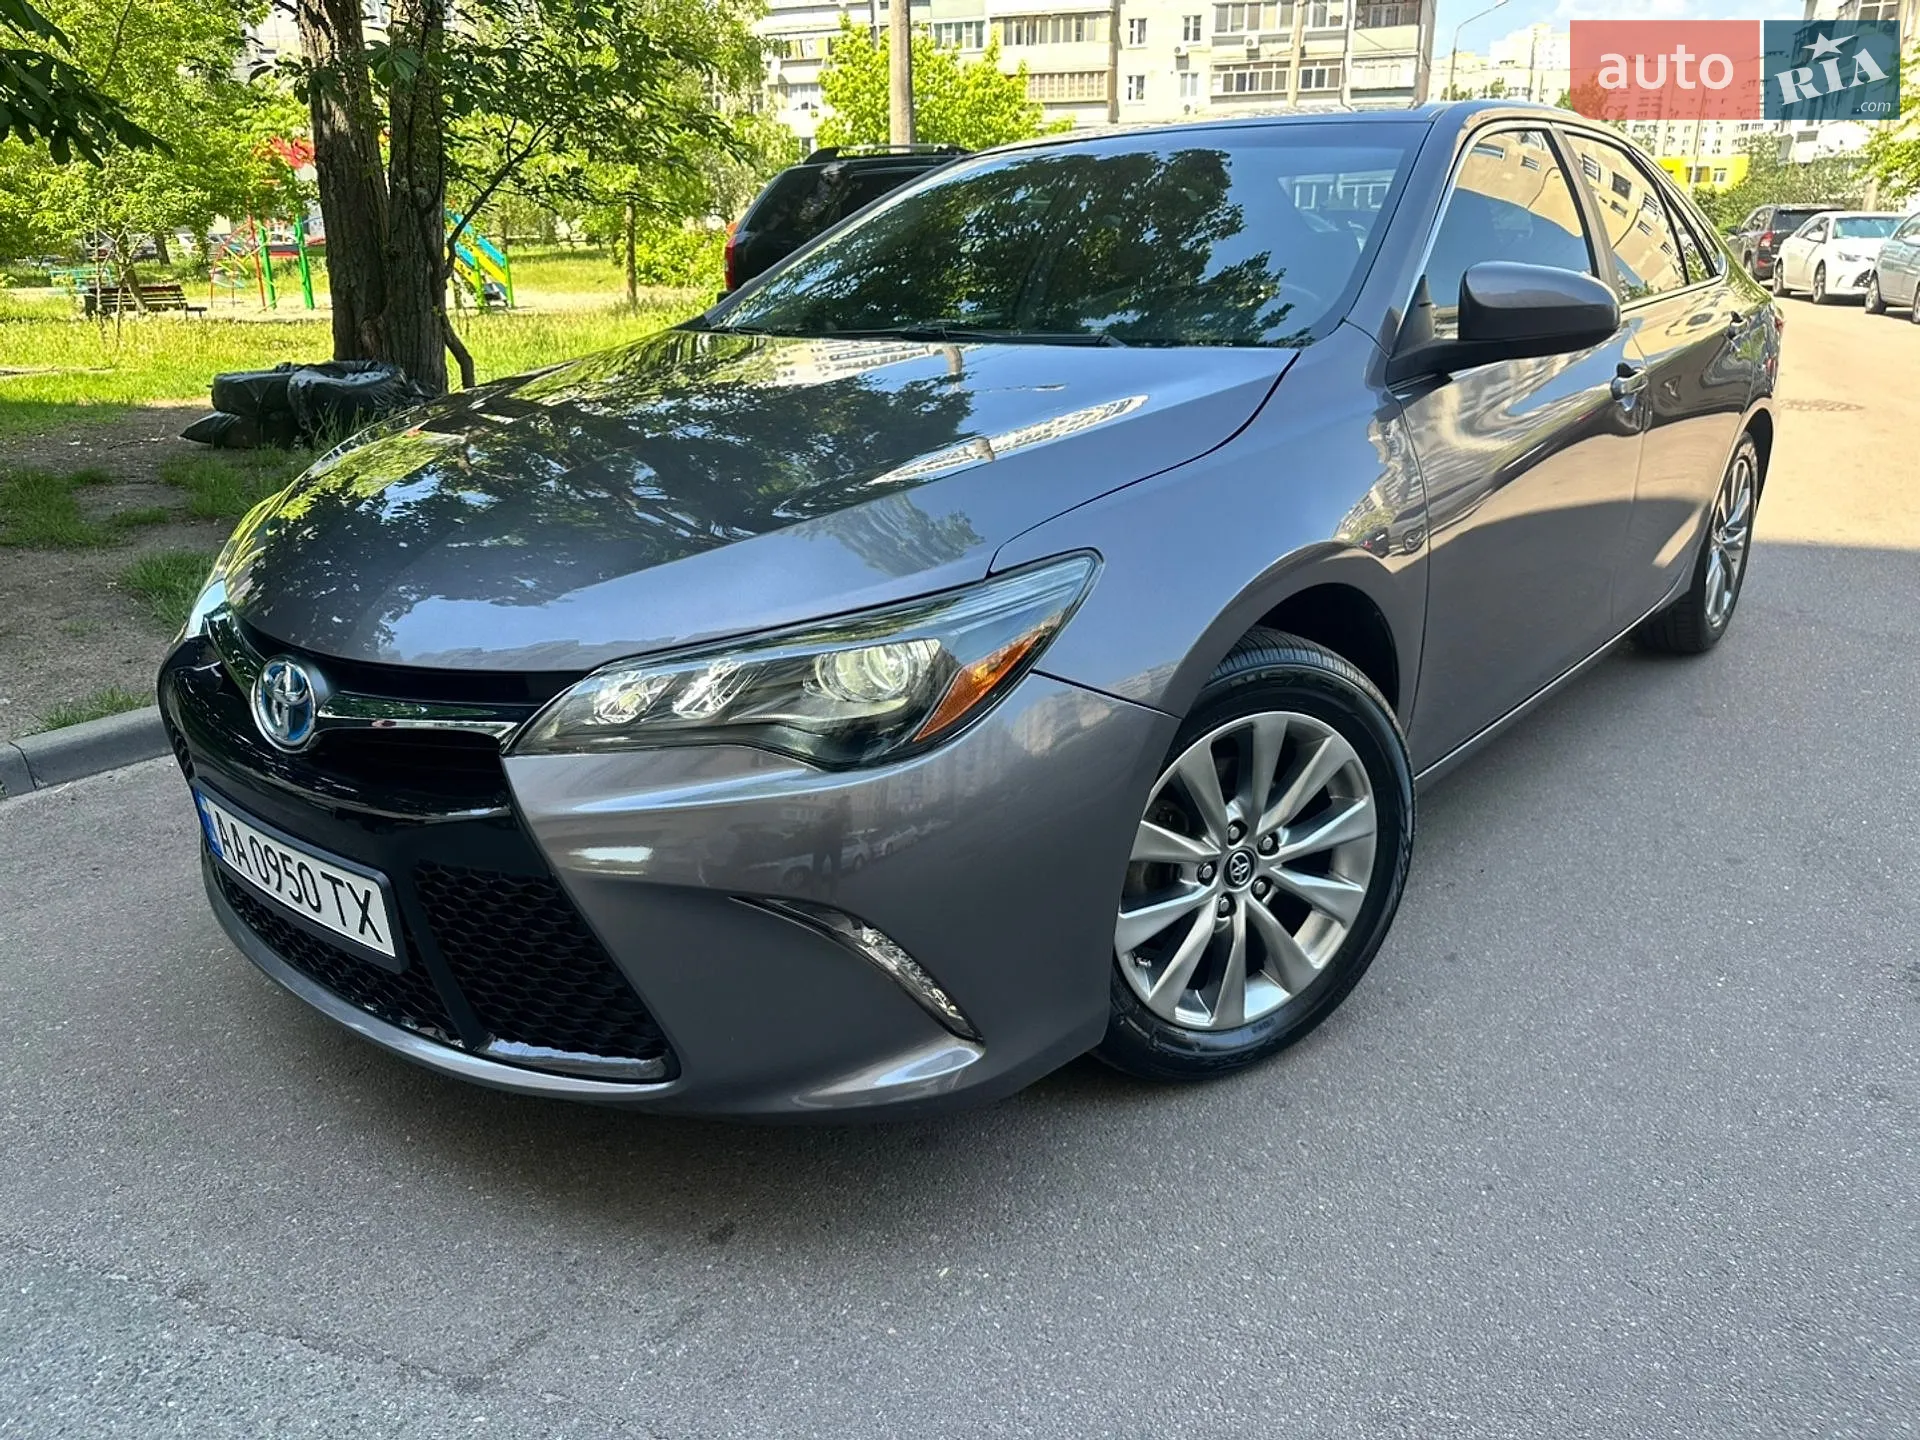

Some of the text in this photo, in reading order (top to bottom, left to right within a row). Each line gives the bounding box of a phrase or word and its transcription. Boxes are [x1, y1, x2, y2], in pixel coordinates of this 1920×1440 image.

[214, 810, 254, 876] AA
[249, 834, 322, 914] 0950
[319, 870, 384, 944] TX
